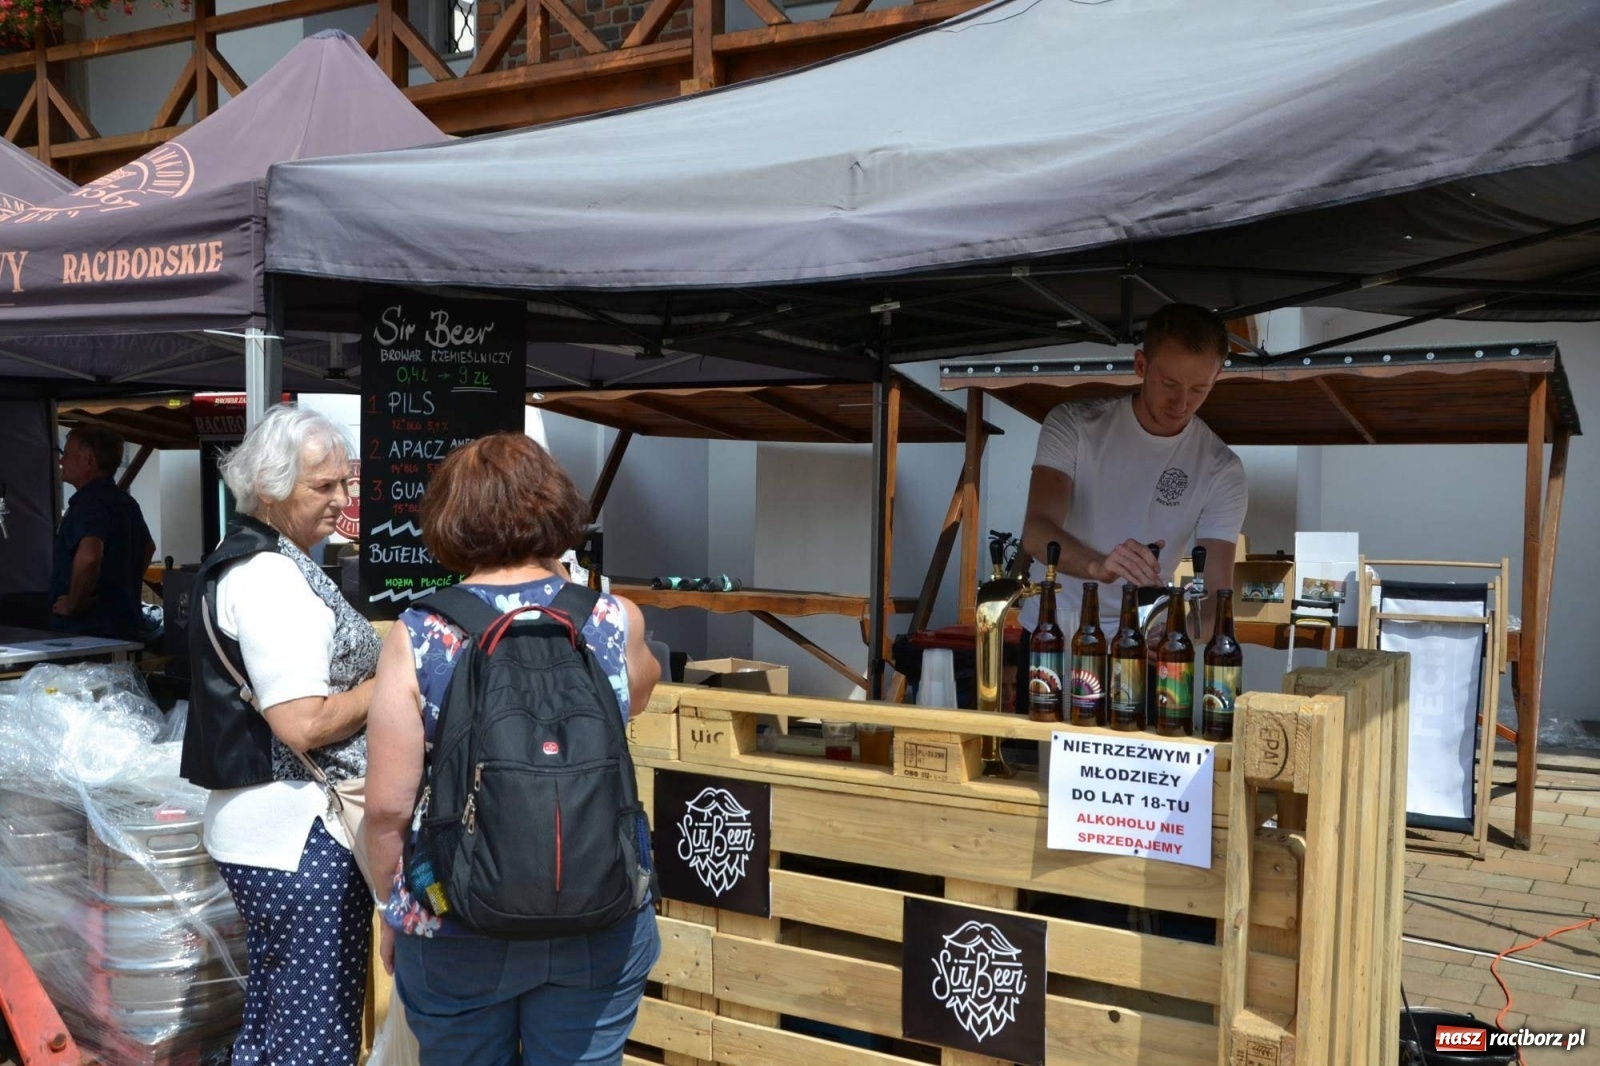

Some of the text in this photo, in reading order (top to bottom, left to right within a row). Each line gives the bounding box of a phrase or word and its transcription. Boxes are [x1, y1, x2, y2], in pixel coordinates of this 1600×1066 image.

[63, 240, 224, 285] RACIBORSKIE
[373, 304, 495, 348] Sir Beer
[380, 348, 513, 364] BROWAR RZEMIEŚLNICZY
[388, 390, 436, 415] PILS
[388, 439, 446, 460] APACZ
[1063, 740, 1191, 764] NIETRZEŹWYM
[1080, 764, 1181, 788] MŁODZIEŻY
[1072, 788, 1190, 813] DO LAT 18-TU
[1077, 813, 1184, 835] ALKOHOLU NIE
[676, 813, 756, 861] Sir Beer
[1077, 831, 1183, 855] SPRZEDAJEMY
[931, 948, 1028, 1001] Sir Beer
